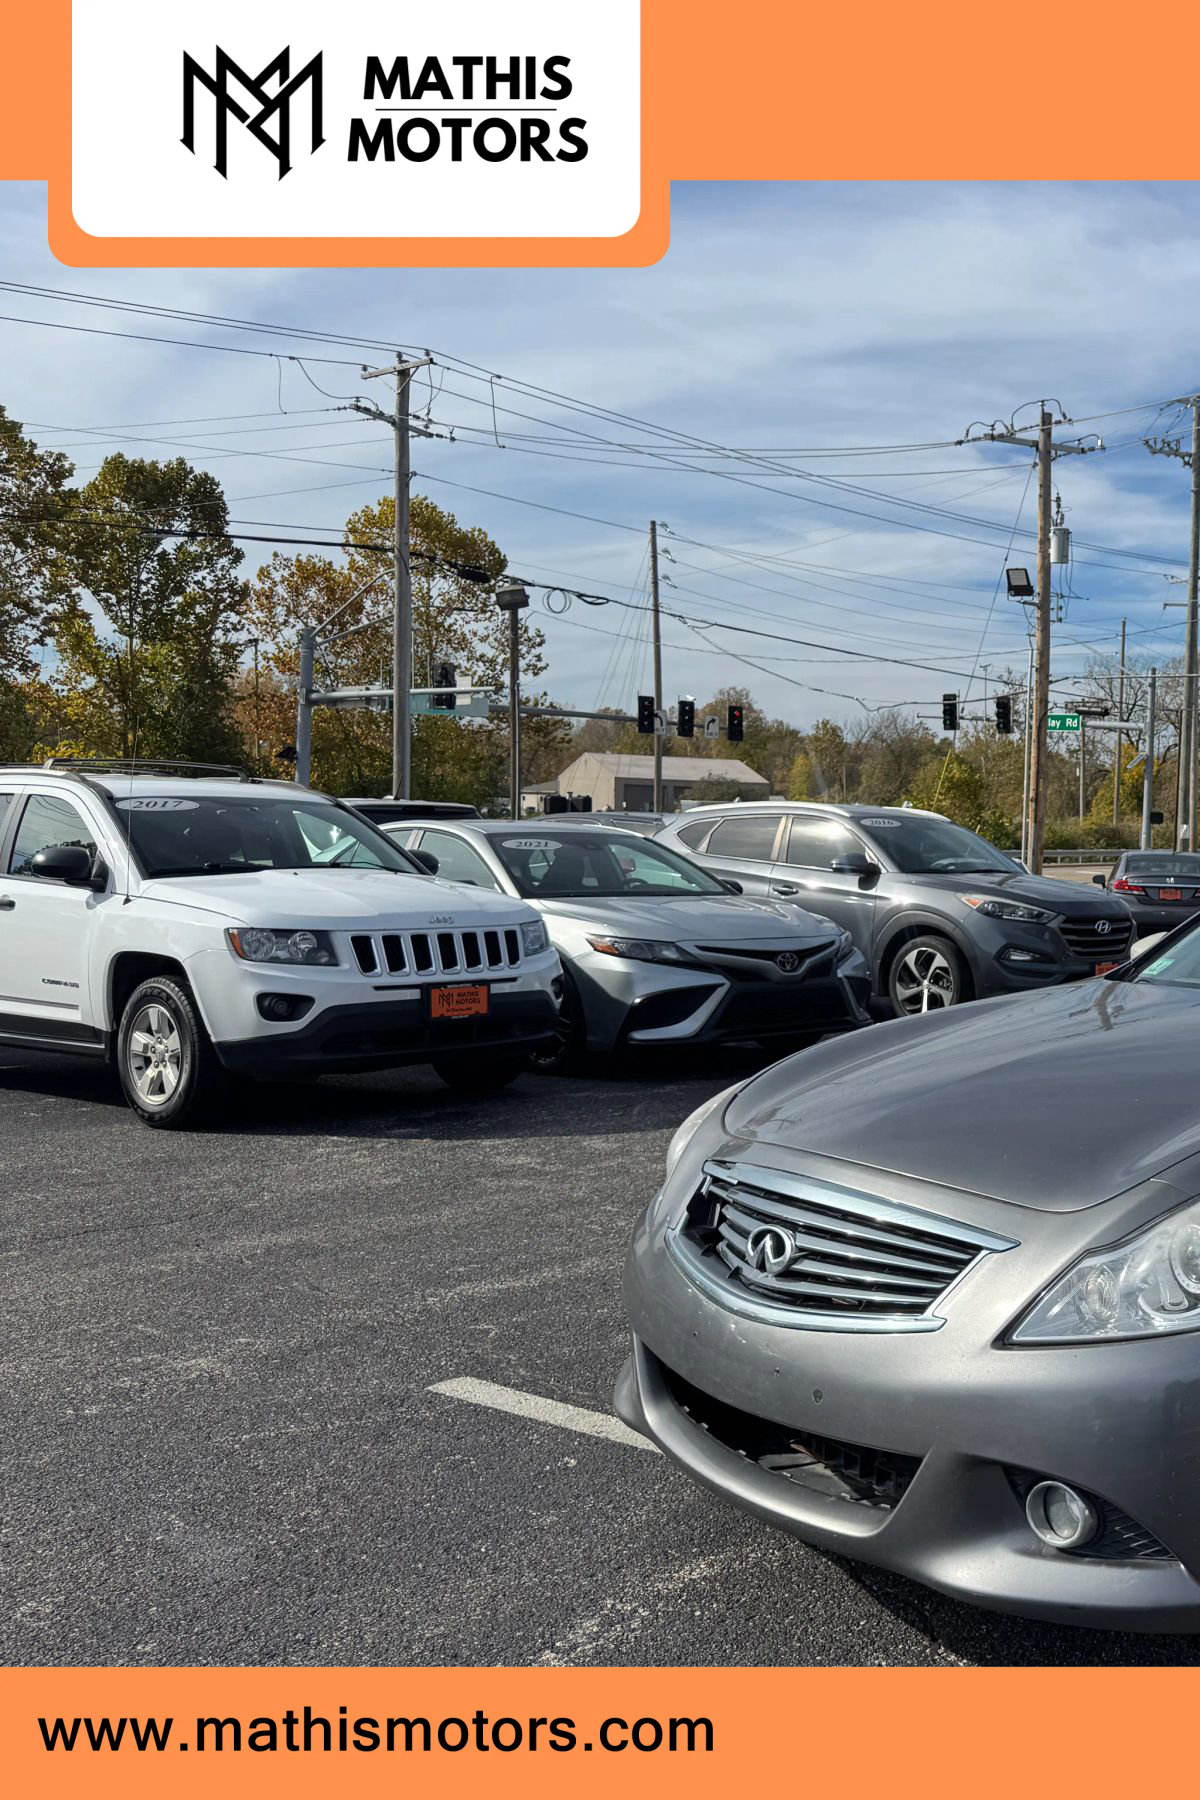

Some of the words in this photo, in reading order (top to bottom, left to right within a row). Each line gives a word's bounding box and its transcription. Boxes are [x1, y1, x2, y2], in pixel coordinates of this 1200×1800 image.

[1048, 717, 1061, 729] lay
[1065, 717, 1078, 728] Rd
[131, 800, 184, 808] 2017
